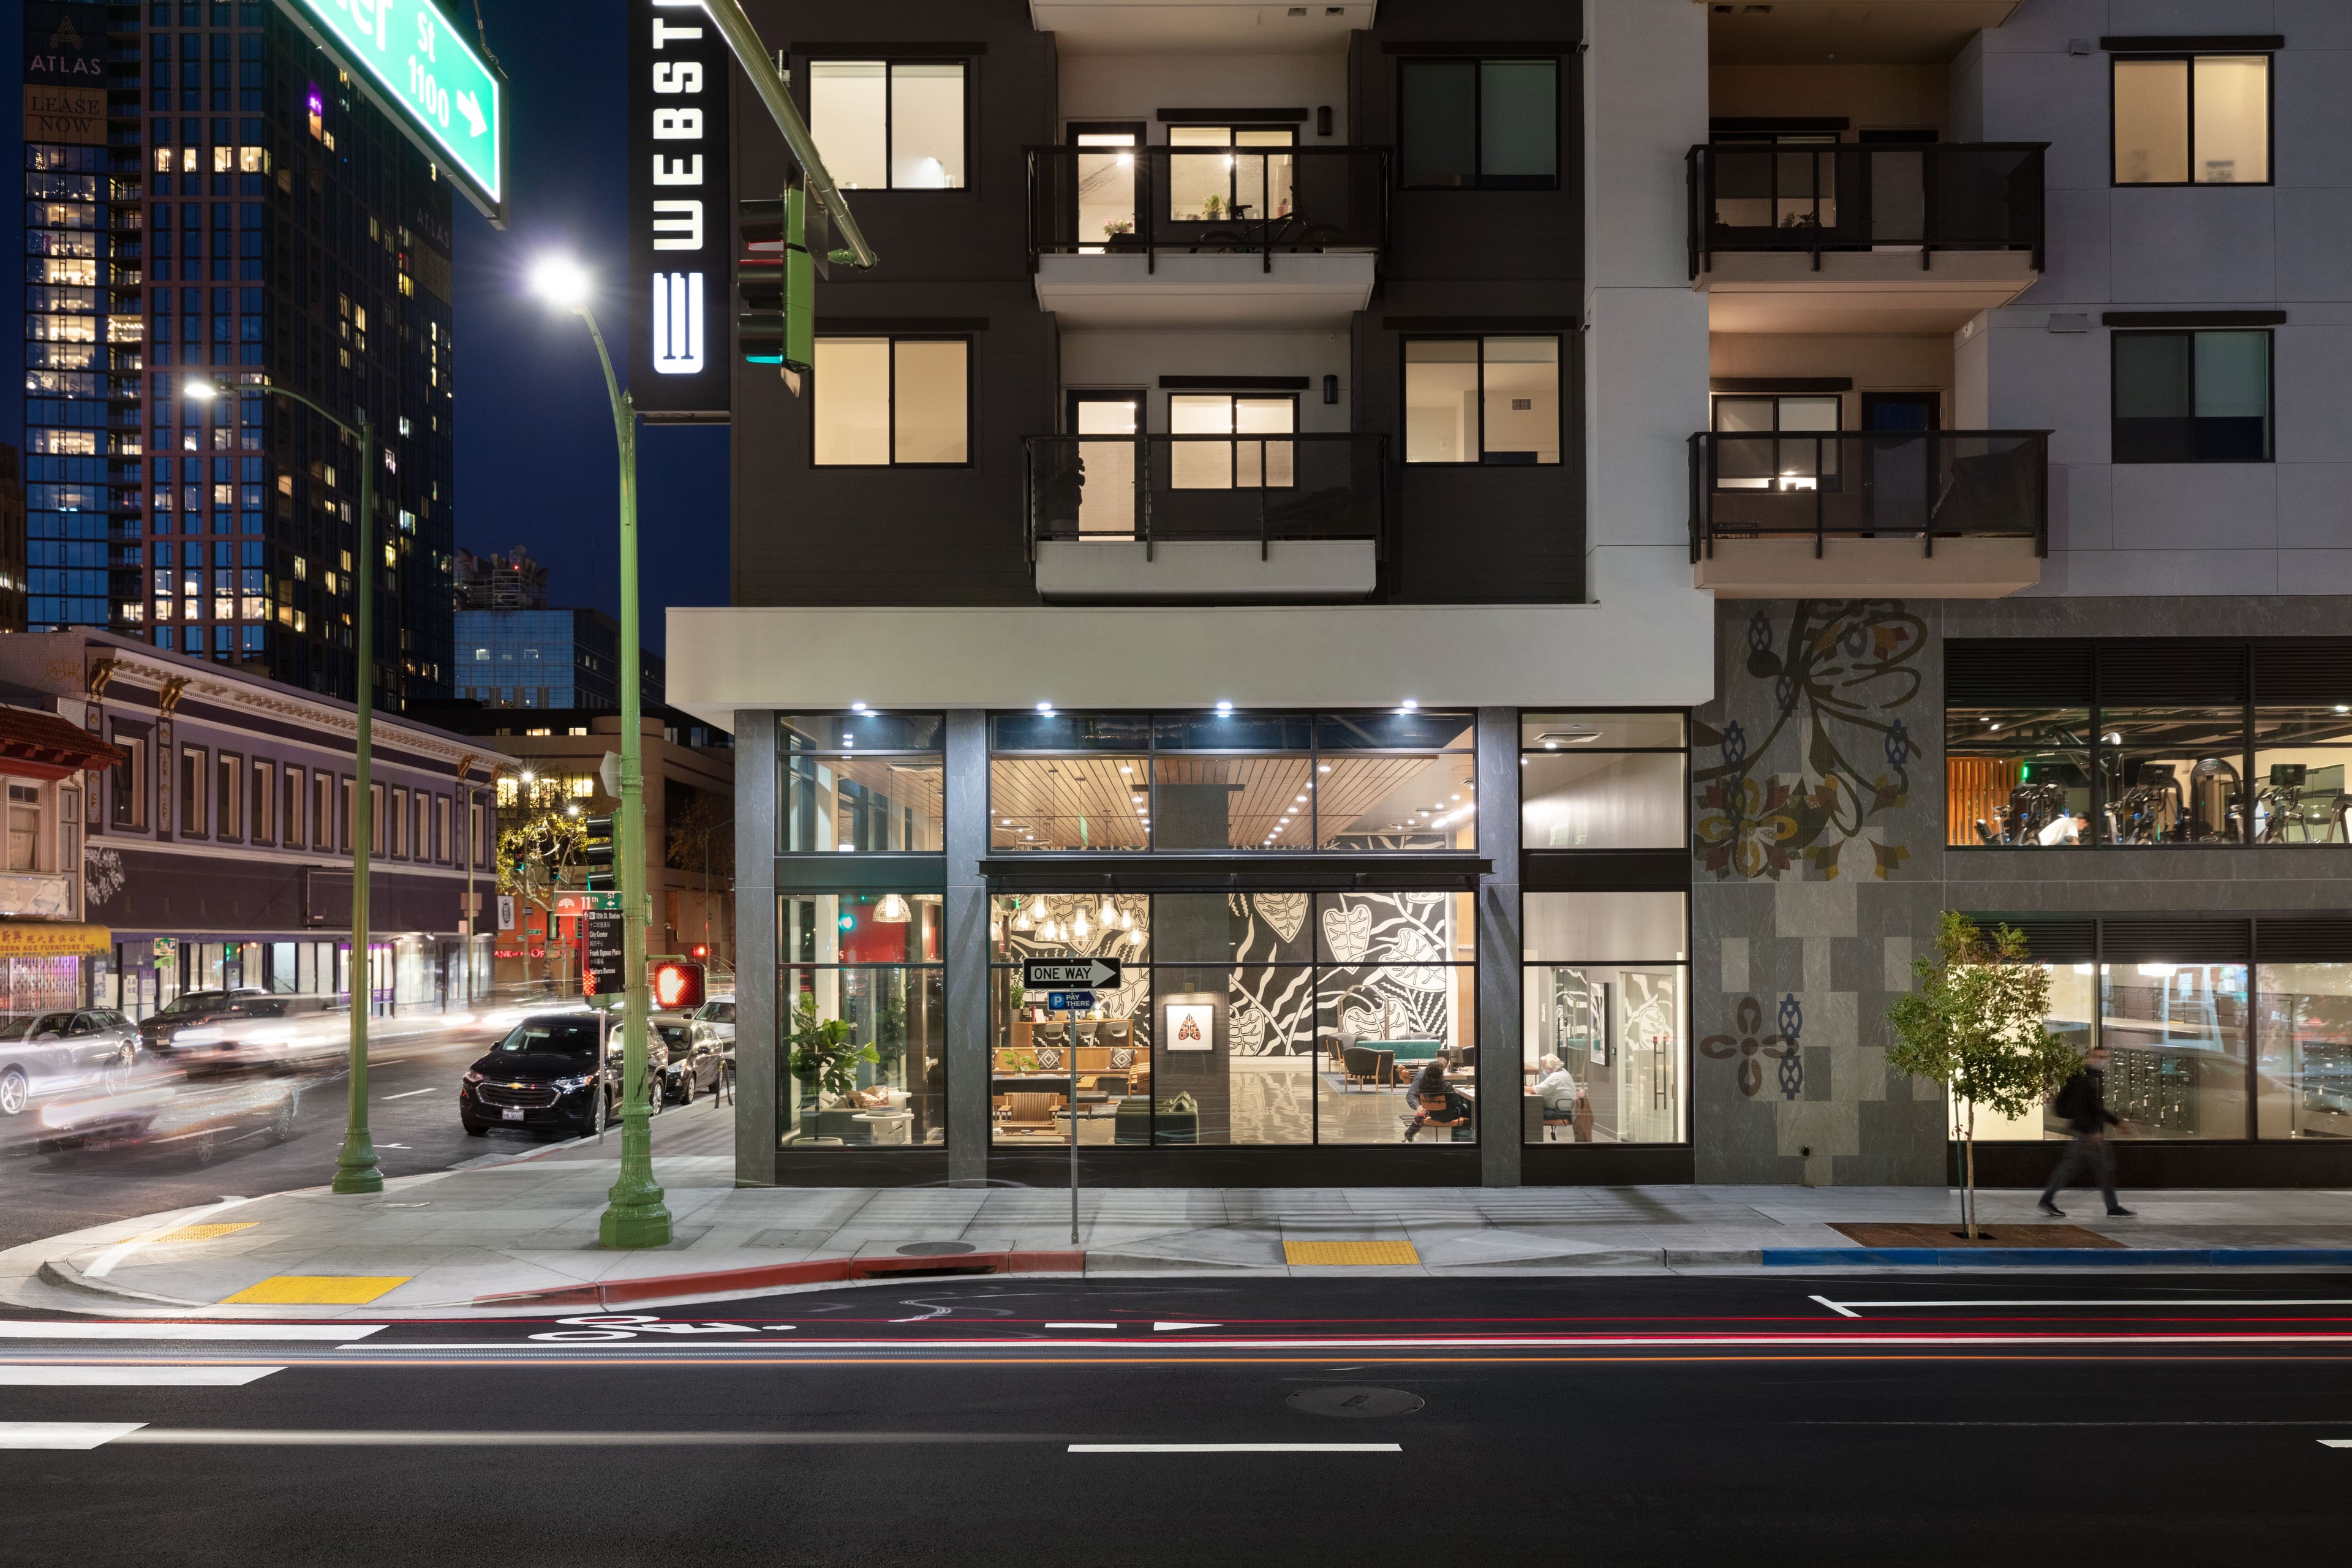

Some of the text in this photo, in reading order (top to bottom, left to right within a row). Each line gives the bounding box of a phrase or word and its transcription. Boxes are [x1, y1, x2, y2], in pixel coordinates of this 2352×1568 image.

[417, 11, 435, 63] St
[30, 55, 102, 75] ATLAS
[408, 55, 450, 128] 1100
[31, 97, 100, 115] LEASE
[39, 116, 94, 134] NOW
[1034, 968, 1091, 979] ONE WAY
